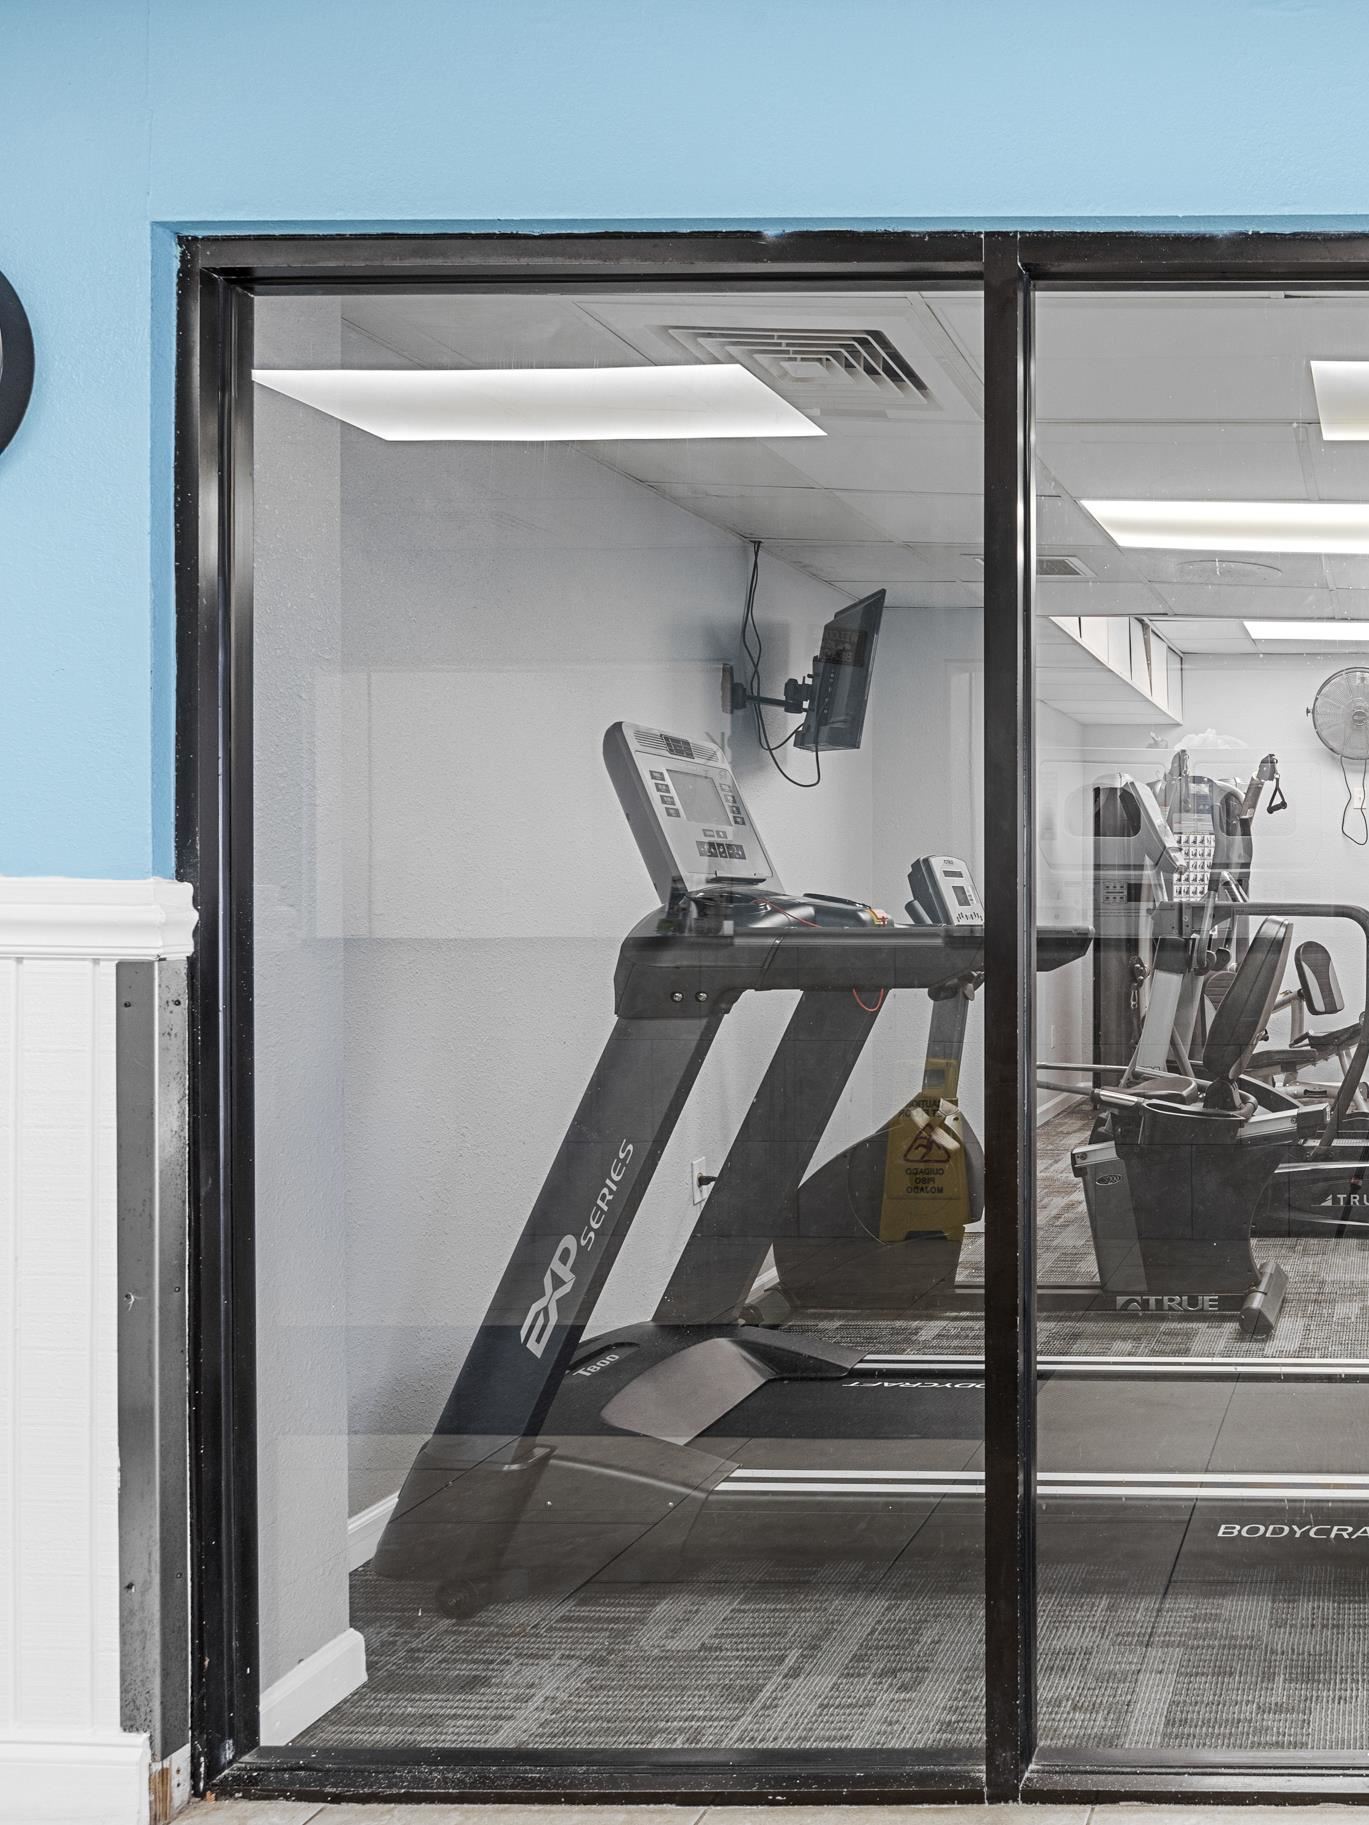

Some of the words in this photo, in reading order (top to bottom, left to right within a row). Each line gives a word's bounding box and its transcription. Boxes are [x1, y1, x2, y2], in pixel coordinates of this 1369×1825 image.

[519, 1234, 578, 1359] EXP
[580, 1138, 634, 1251] SERIES
[1142, 1295, 1219, 1311] TRUE
[572, 1353, 620, 1377] T800
[842, 1381, 986, 1389] DYCRAFT
